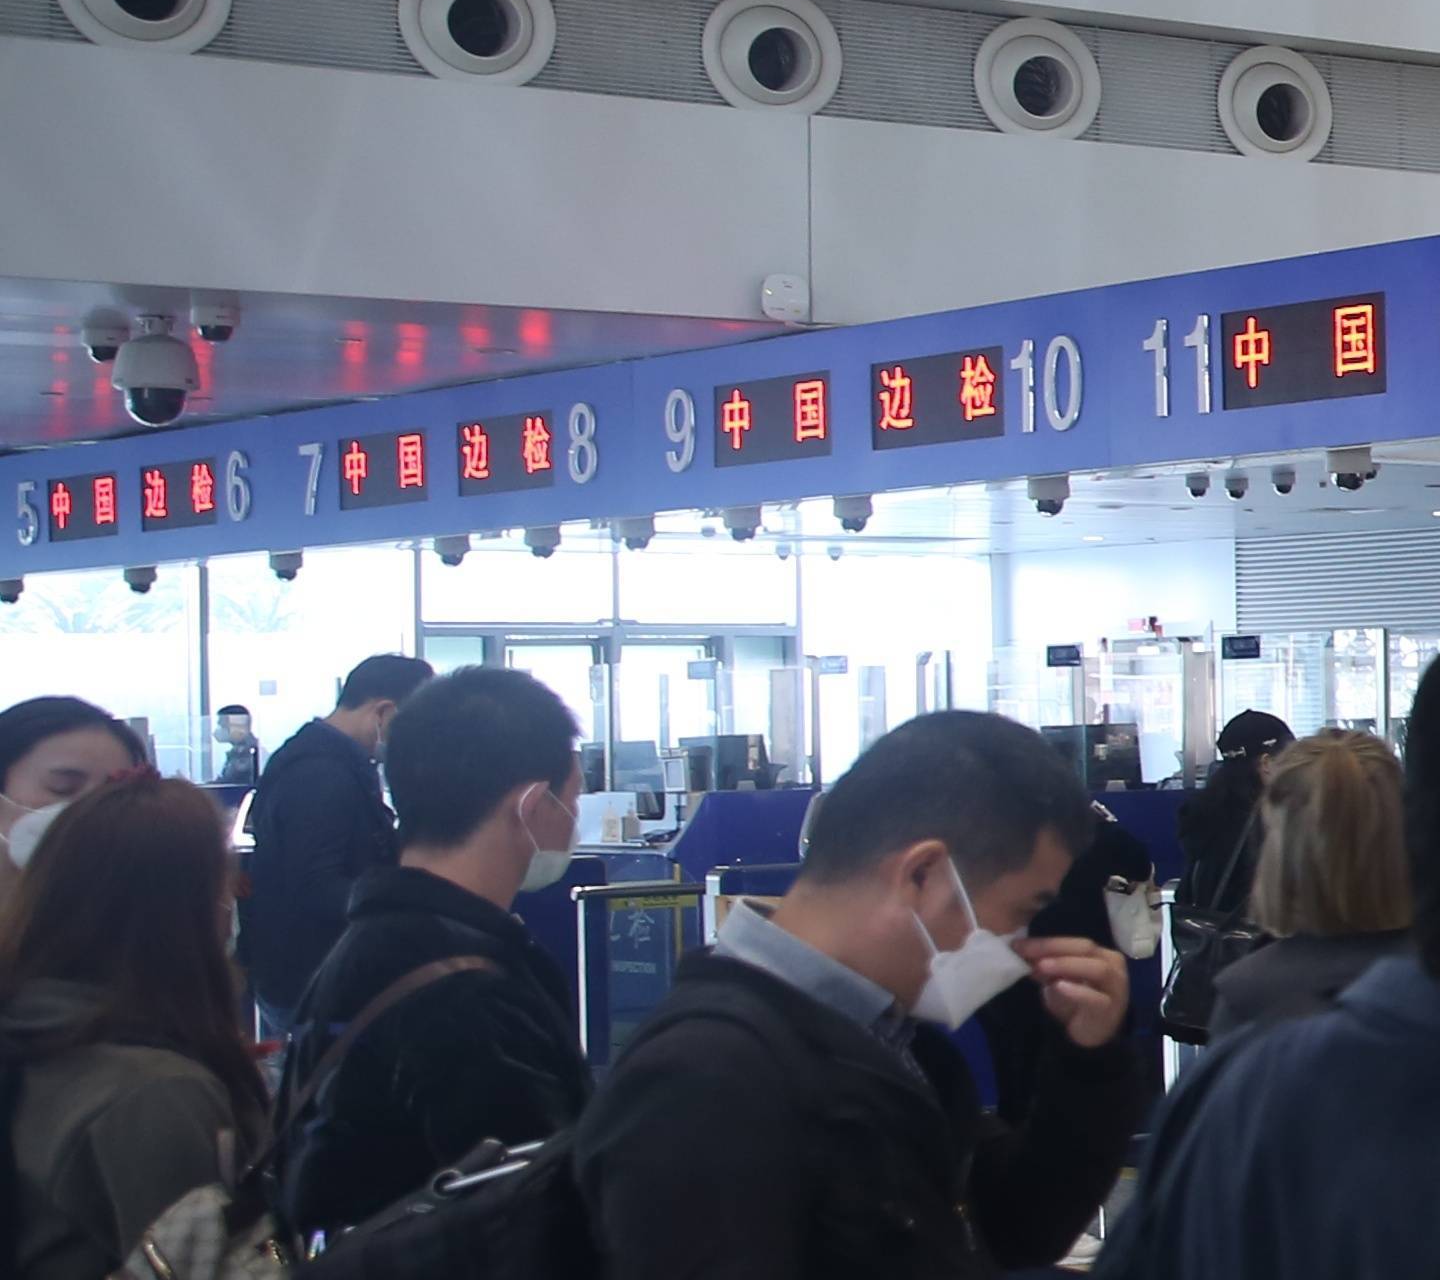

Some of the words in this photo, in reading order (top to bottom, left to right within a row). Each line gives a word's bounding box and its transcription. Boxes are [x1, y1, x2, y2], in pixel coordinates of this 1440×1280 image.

[1142, 314, 1211, 417] 11
[1233, 303, 1376, 389] 中国
[721, 379, 826, 450] 中国
[878, 355, 996, 430] 边检
[1009, 334, 1082, 433] 10
[343, 433, 424, 494] 中国
[461, 417, 552, 479] 边检
[567, 403, 599, 484] 8
[664, 388, 696, 473] 9
[16, 481, 39, 546] 5
[225, 450, 251, 521] 6
[298, 443, 325, 516] 7
